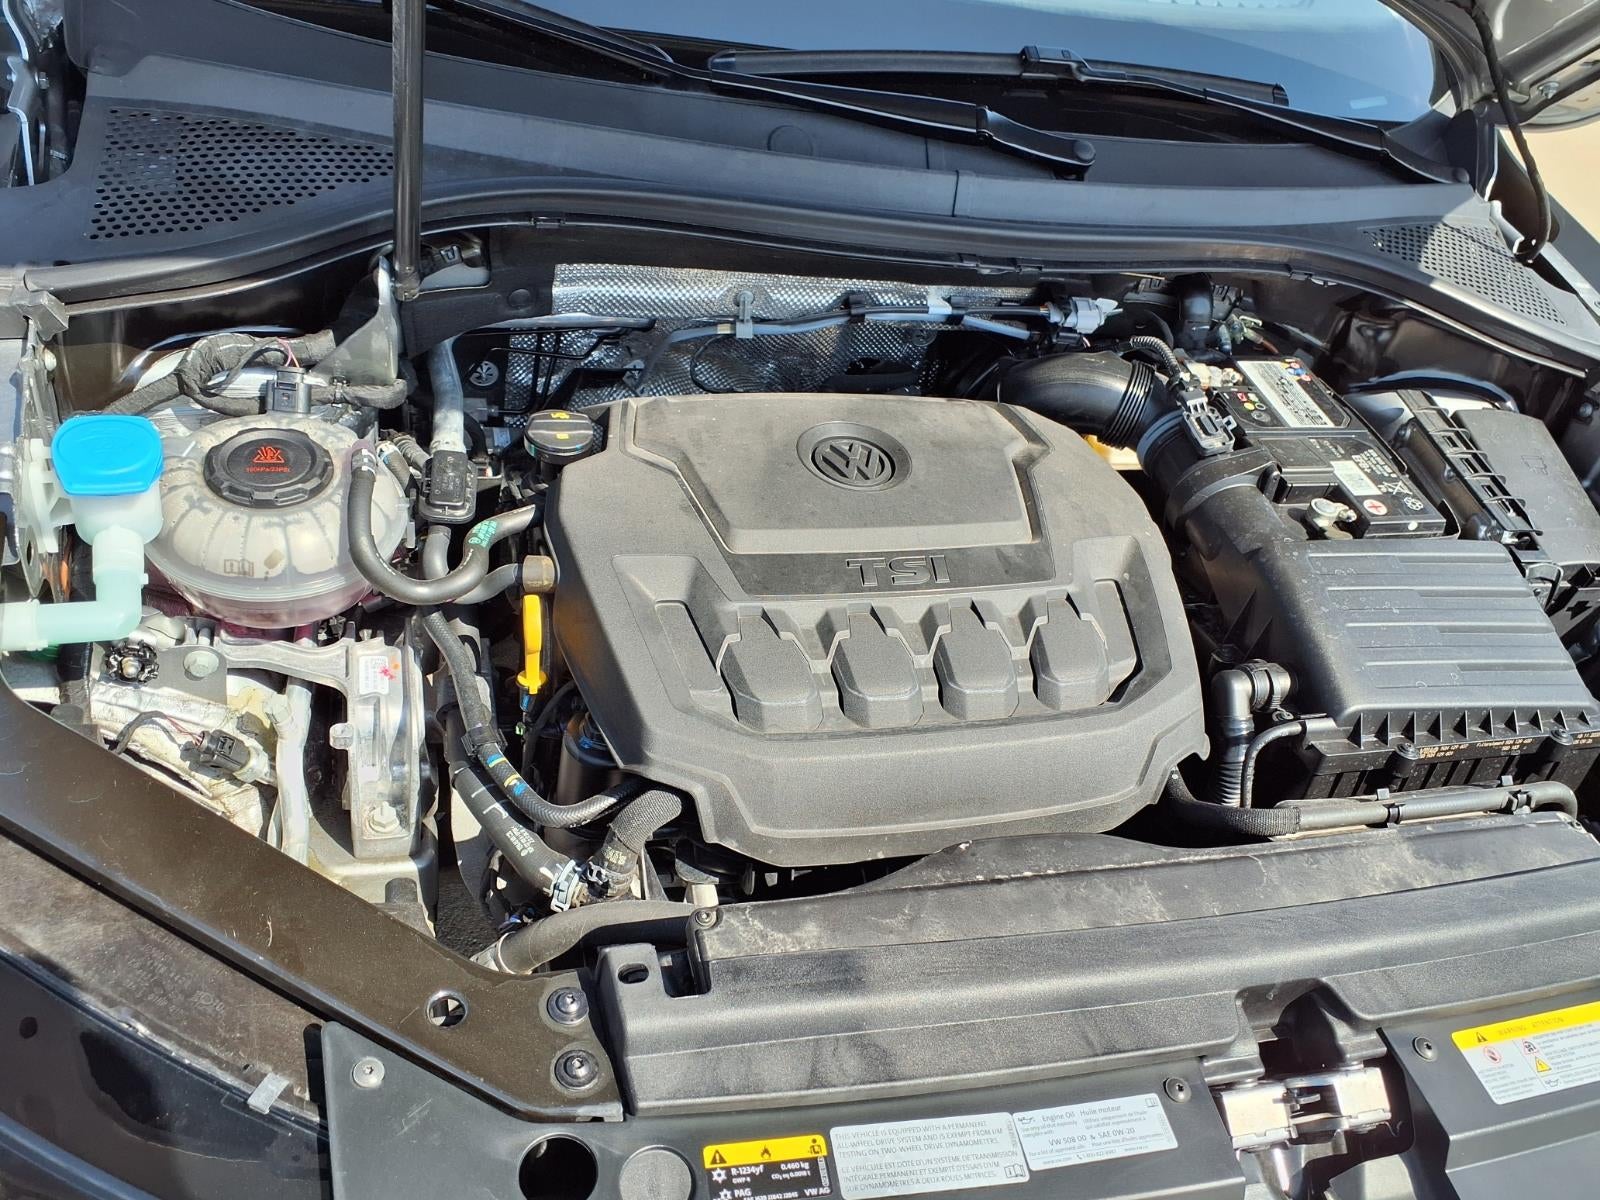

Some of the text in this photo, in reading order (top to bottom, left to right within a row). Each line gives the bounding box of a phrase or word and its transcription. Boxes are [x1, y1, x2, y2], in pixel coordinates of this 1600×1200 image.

[846, 554, 951, 587] TSI
[1079, 1105, 1121, 1117] Huile moteur
[1042, 1113, 1065, 1123] Engine
[853, 1128, 879, 1139] VEHICLE
[888, 1126, 921, 1136] EQUIPPED
[922, 1123, 940, 1132] WITH
[948, 1120, 986, 1130] PERMANENT
[876, 1137, 895, 1146] DRIVE
[896, 1135, 922, 1144] SYSTEM
[923, 1132, 938, 1141] AND
[946, 1130, 970, 1139] EXEMPT
[972, 1128, 991, 1136] FROM
[1048, 1138, 1062, 1146] VW
[1062, 1136, 1077, 1144] 508
[1098, 1130, 1112, 1139] SAE
[839, 1149, 867, 1158] TESTING
[868, 1148, 879, 1156] ON
[923, 1141, 944, 1150] DRIVE
[730, 1164, 764, 1176] R-1234yf
[780, 1160, 810, 1171] 0.460 kg
[734, 1187, 752, 1198] PAG
[803, 1186, 831, 1197] VW AG
